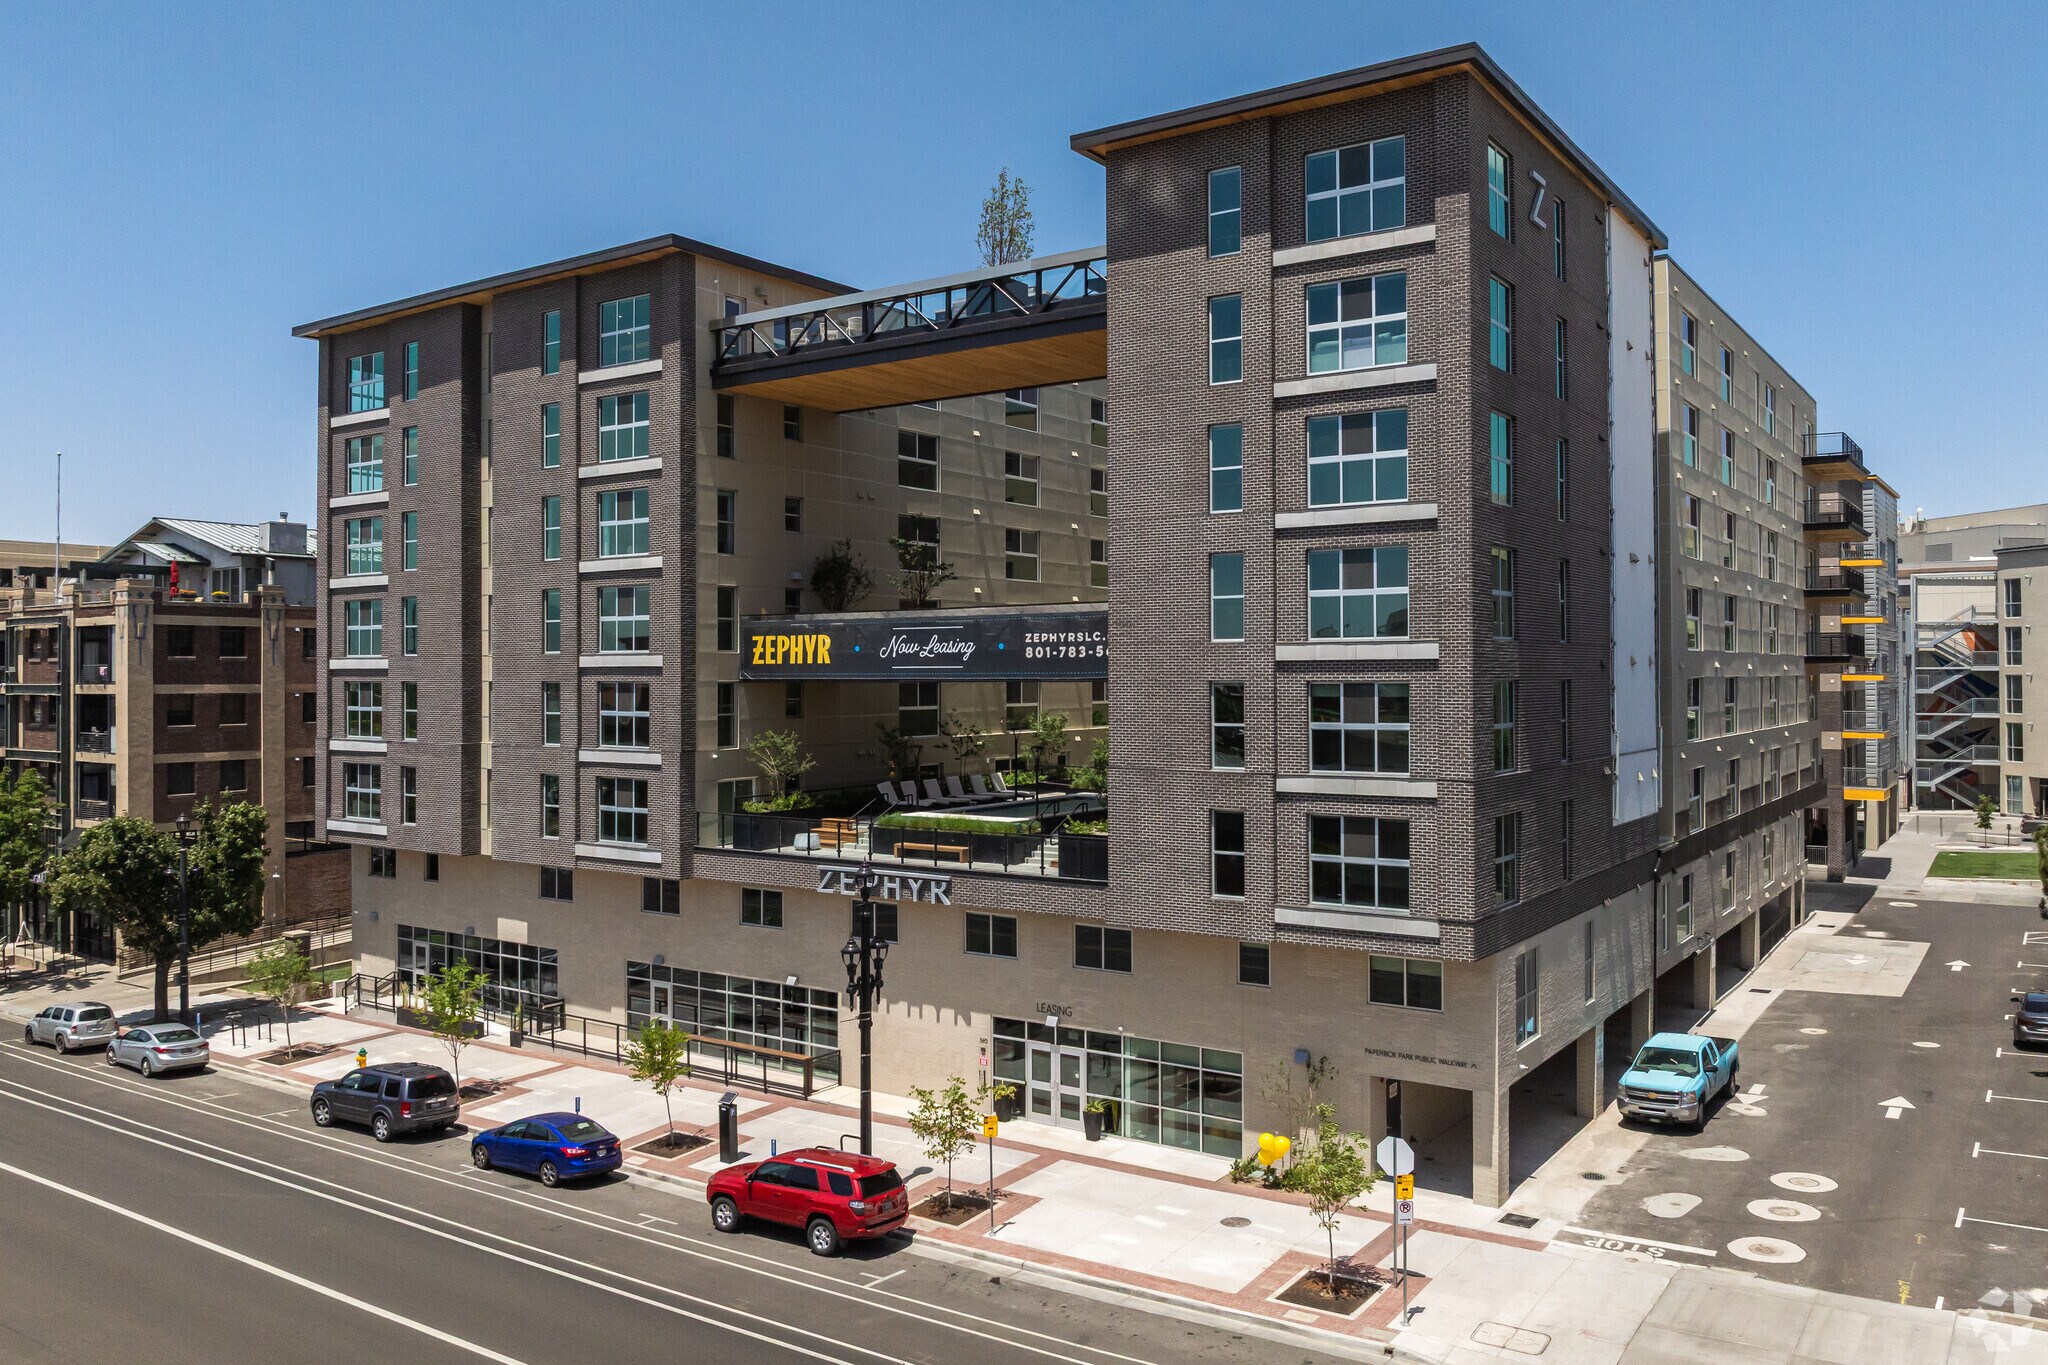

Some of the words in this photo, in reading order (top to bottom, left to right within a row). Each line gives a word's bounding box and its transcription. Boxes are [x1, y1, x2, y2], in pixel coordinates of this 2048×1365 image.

[1025, 632, 1108, 643] ZEPHYRSLC.
[752, 634, 831, 665] ZEPHYR
[880, 635, 921, 658] Now
[919, 634, 976, 661] Leasing
[1025, 645, 1109, 658] 801-783-5
[1036, 1002, 1073, 1017] LEASING
[1364, 1048, 1397, 1058] PAPERBOX
[1398, 1052, 1413, 1061] PARK
[1415, 1054, 1437, 1064] PUBLIC
[1438, 1058, 1468, 1069] WALKWAY
